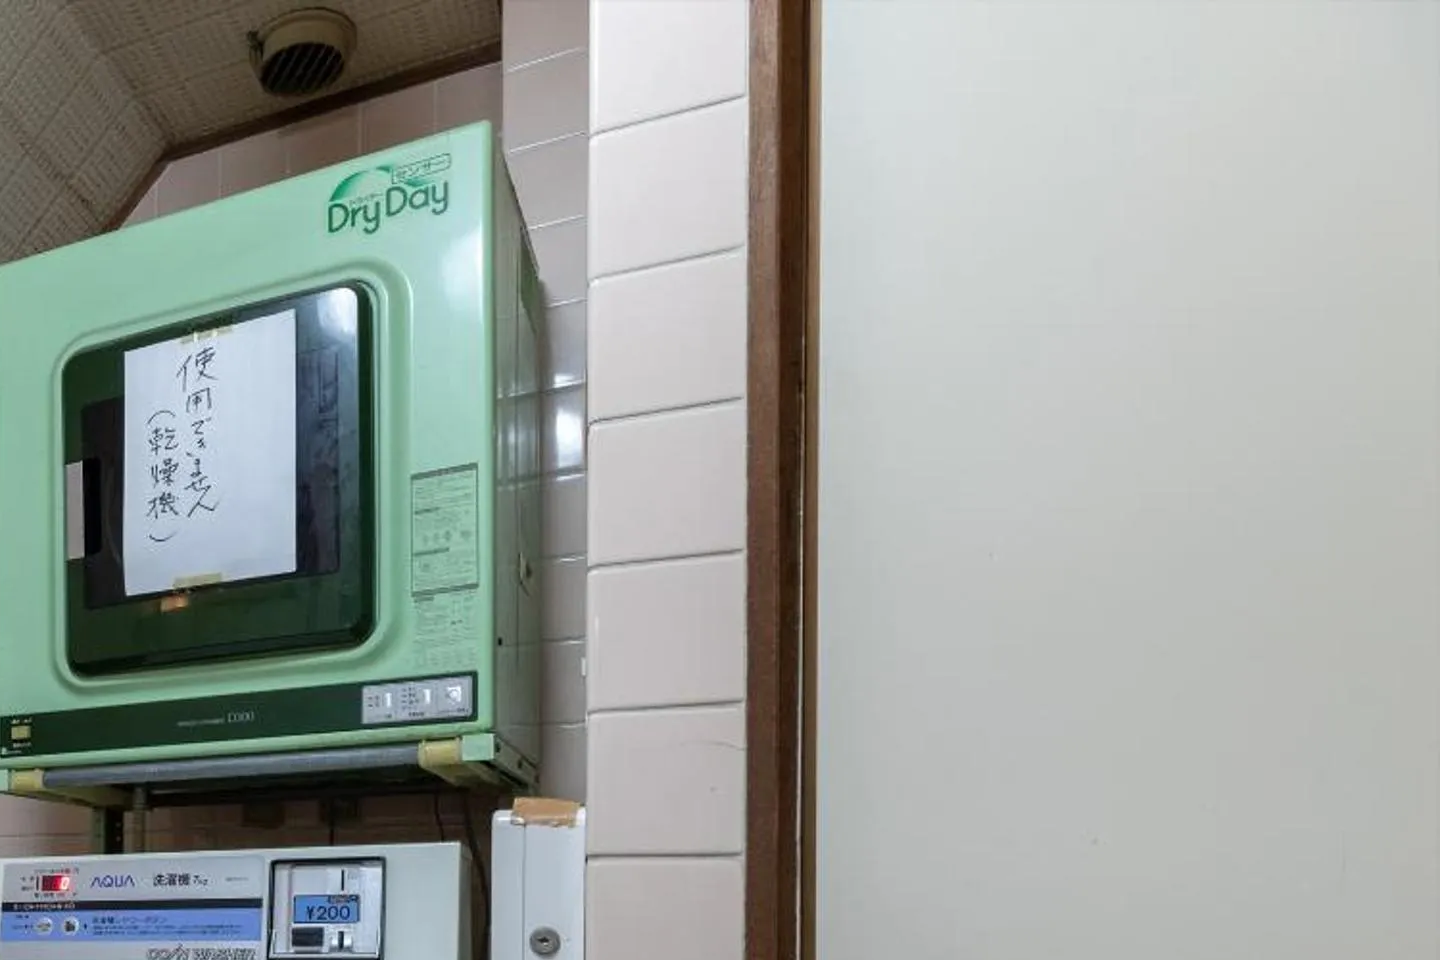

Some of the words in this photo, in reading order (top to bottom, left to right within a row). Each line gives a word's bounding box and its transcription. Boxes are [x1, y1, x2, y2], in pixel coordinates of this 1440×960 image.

[176, 346, 220, 518] 使用できません
[90, 874, 136, 889] AQUA
[152, 873, 190, 887] 洗濯機
[306, 905, 350, 921] ¥200
[146, 943, 190, 960] COIN
[191, 947, 257, 960] WASHER
